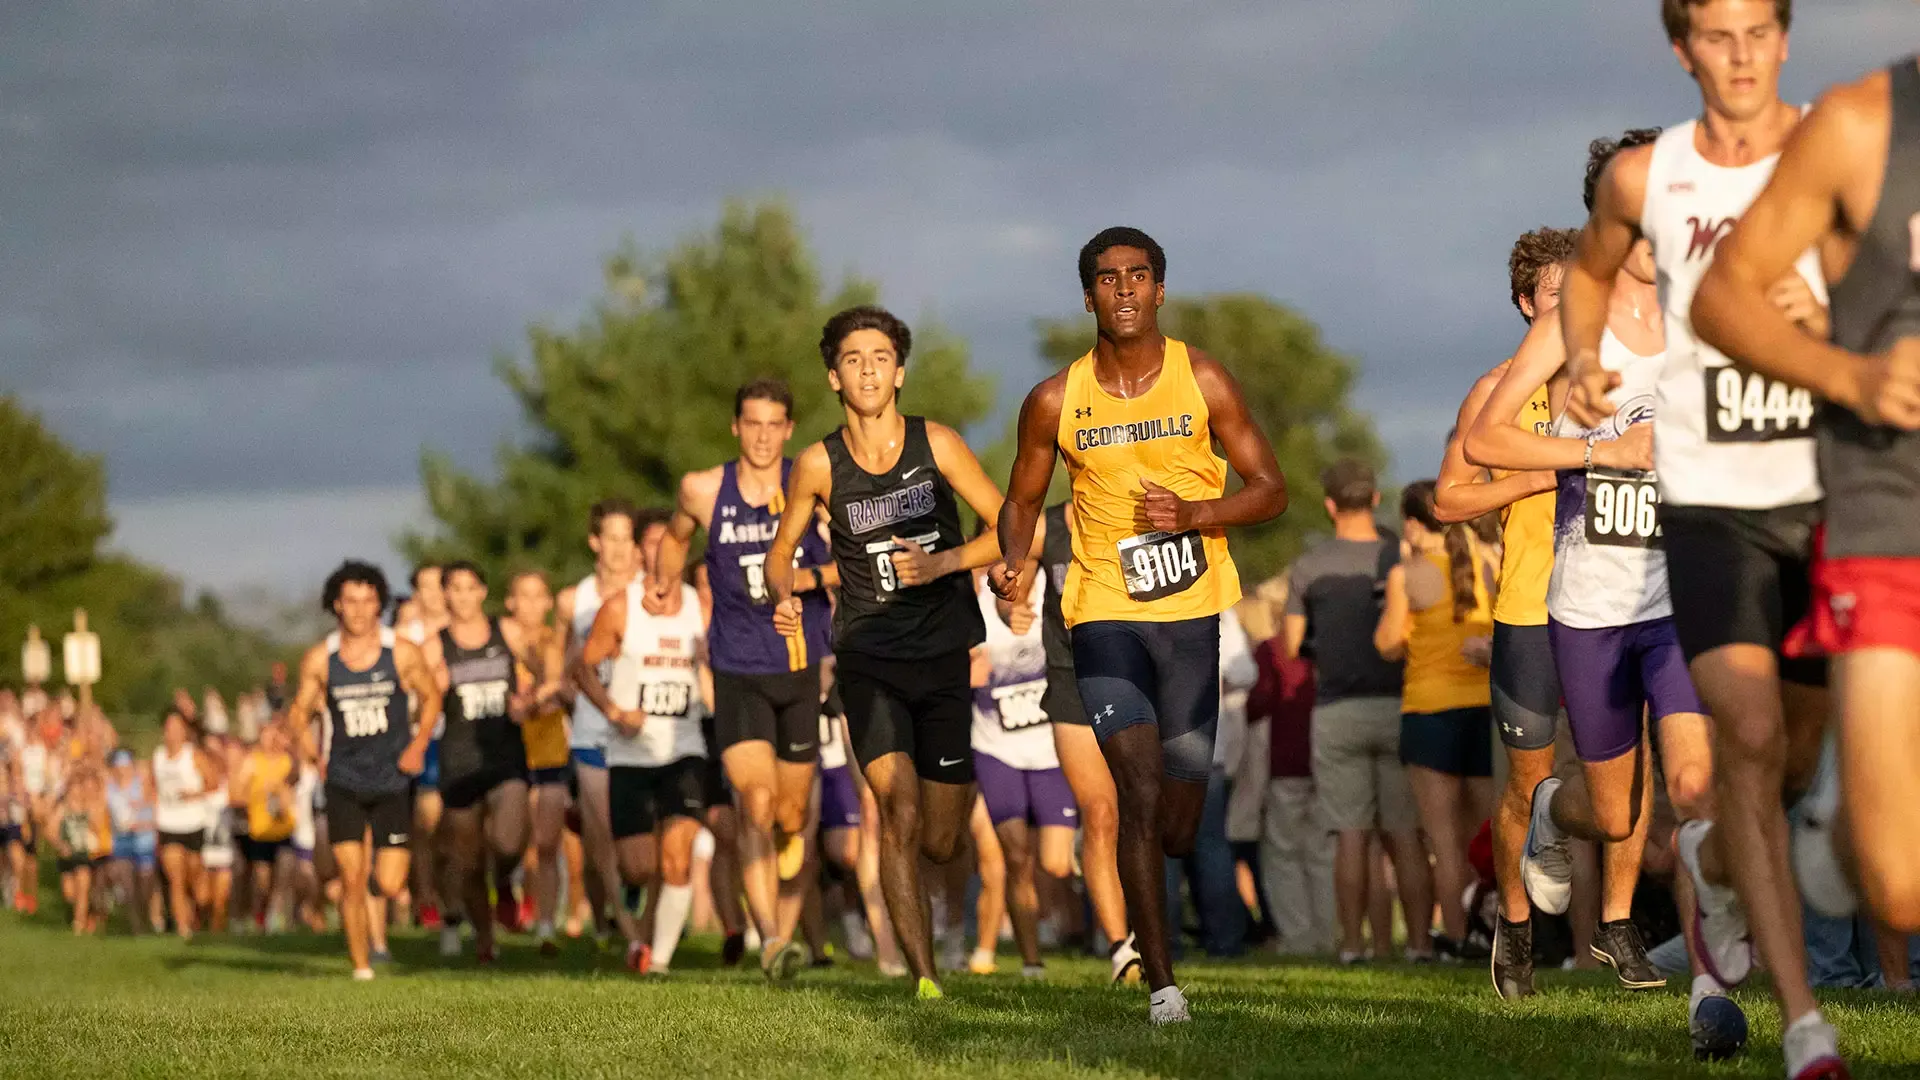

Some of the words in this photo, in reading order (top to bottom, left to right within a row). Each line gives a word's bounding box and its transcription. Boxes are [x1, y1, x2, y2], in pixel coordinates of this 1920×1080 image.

[1716, 367, 1814, 432] 9444
[1075, 414, 1193, 452] CEDARVILLE
[846, 480, 937, 533] RAIDERS
[1132, 535, 1198, 592] 9104
